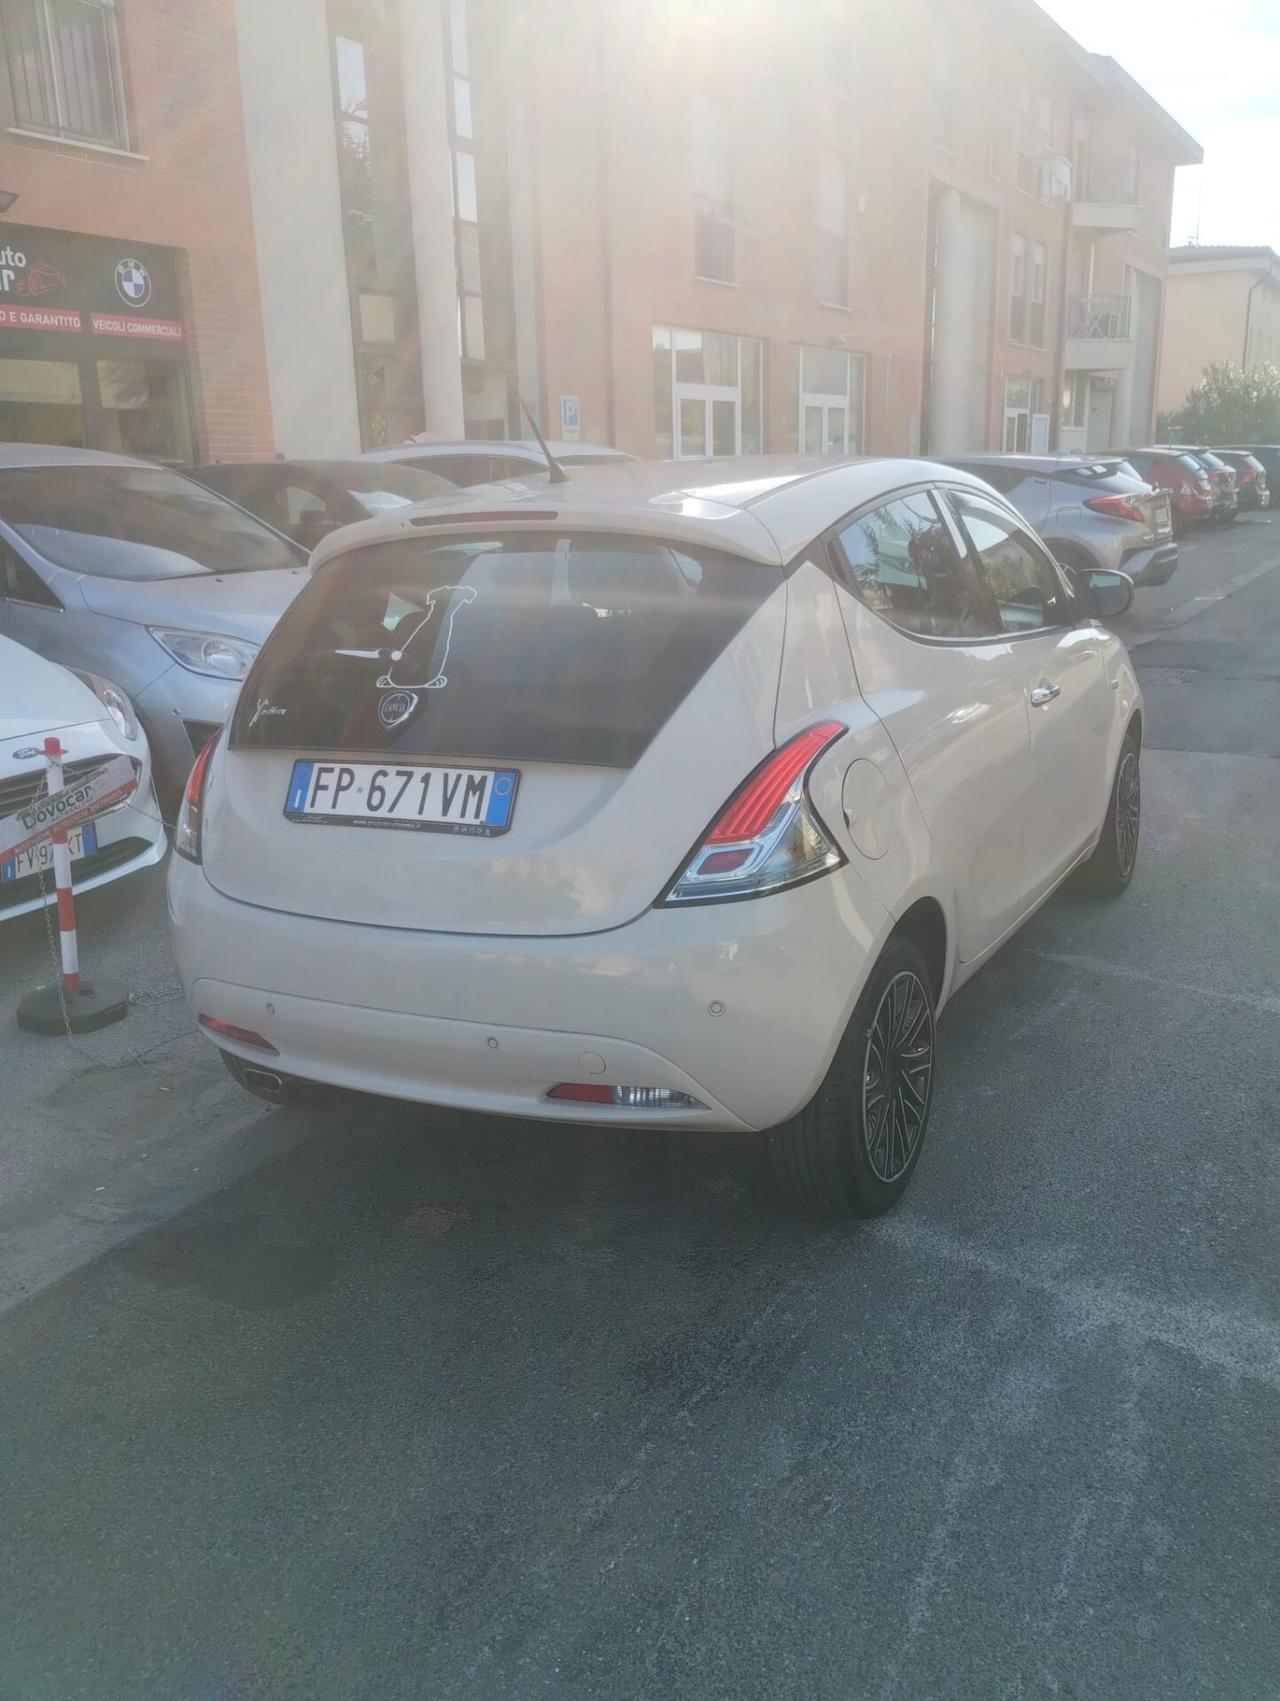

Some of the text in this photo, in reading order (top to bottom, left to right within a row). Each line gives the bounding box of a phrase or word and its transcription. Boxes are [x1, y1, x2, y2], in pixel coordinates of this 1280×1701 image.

[10, 311, 17, 322] E
[20, 312, 81, 328] GARANTITO
[92, 319, 182, 337] VEICOLI COMMERCIALI
[566, 401, 575, 424] P
[309, 767, 488, 820] FP 671VM
[16, 848, 34, 873] FV
